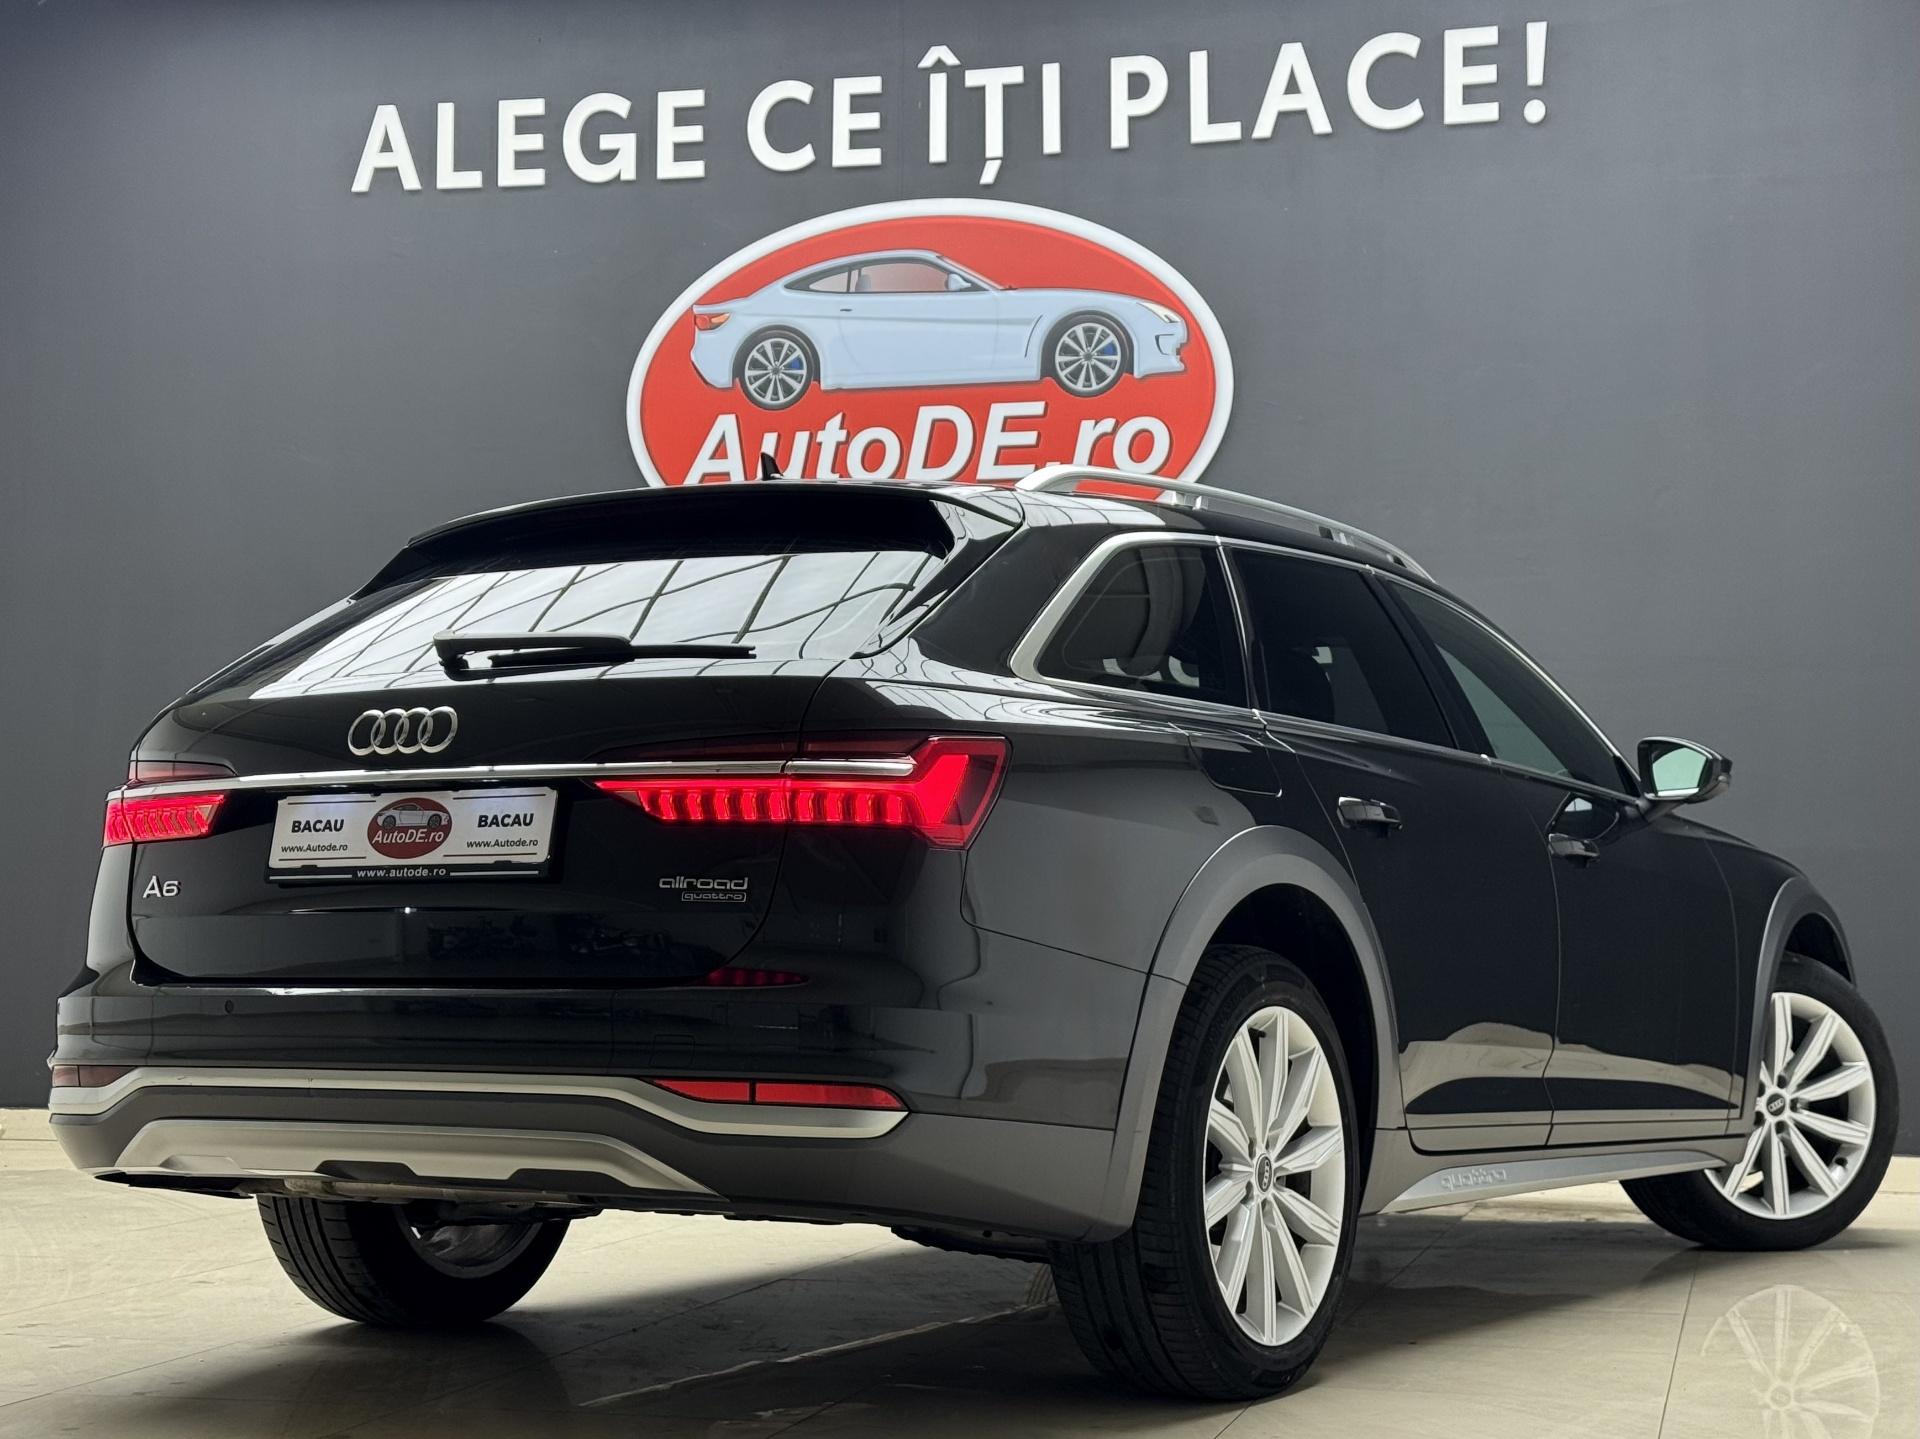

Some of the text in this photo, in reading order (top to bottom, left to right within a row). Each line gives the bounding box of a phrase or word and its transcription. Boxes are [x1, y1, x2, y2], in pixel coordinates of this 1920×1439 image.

[351, 20, 1549, 193] ALEGE CE ÎȚI PLACE!
[682, 400, 1171, 486] AutoDEro
[291, 818, 345, 834] BACAU
[477, 812, 535, 829] BACAU
[371, 828, 445, 845] AutoDE.ro
[465, 837, 539, 849] www.Autode.ro
[280, 842, 349, 854] www.Autode.ro
[356, 866, 447, 878] www.autode.ro
[142, 875, 179, 899] A6
[658, 876, 749, 890] allroad
[683, 892, 744, 901] quattro
[1440, 1167, 1508, 1192] quattro
